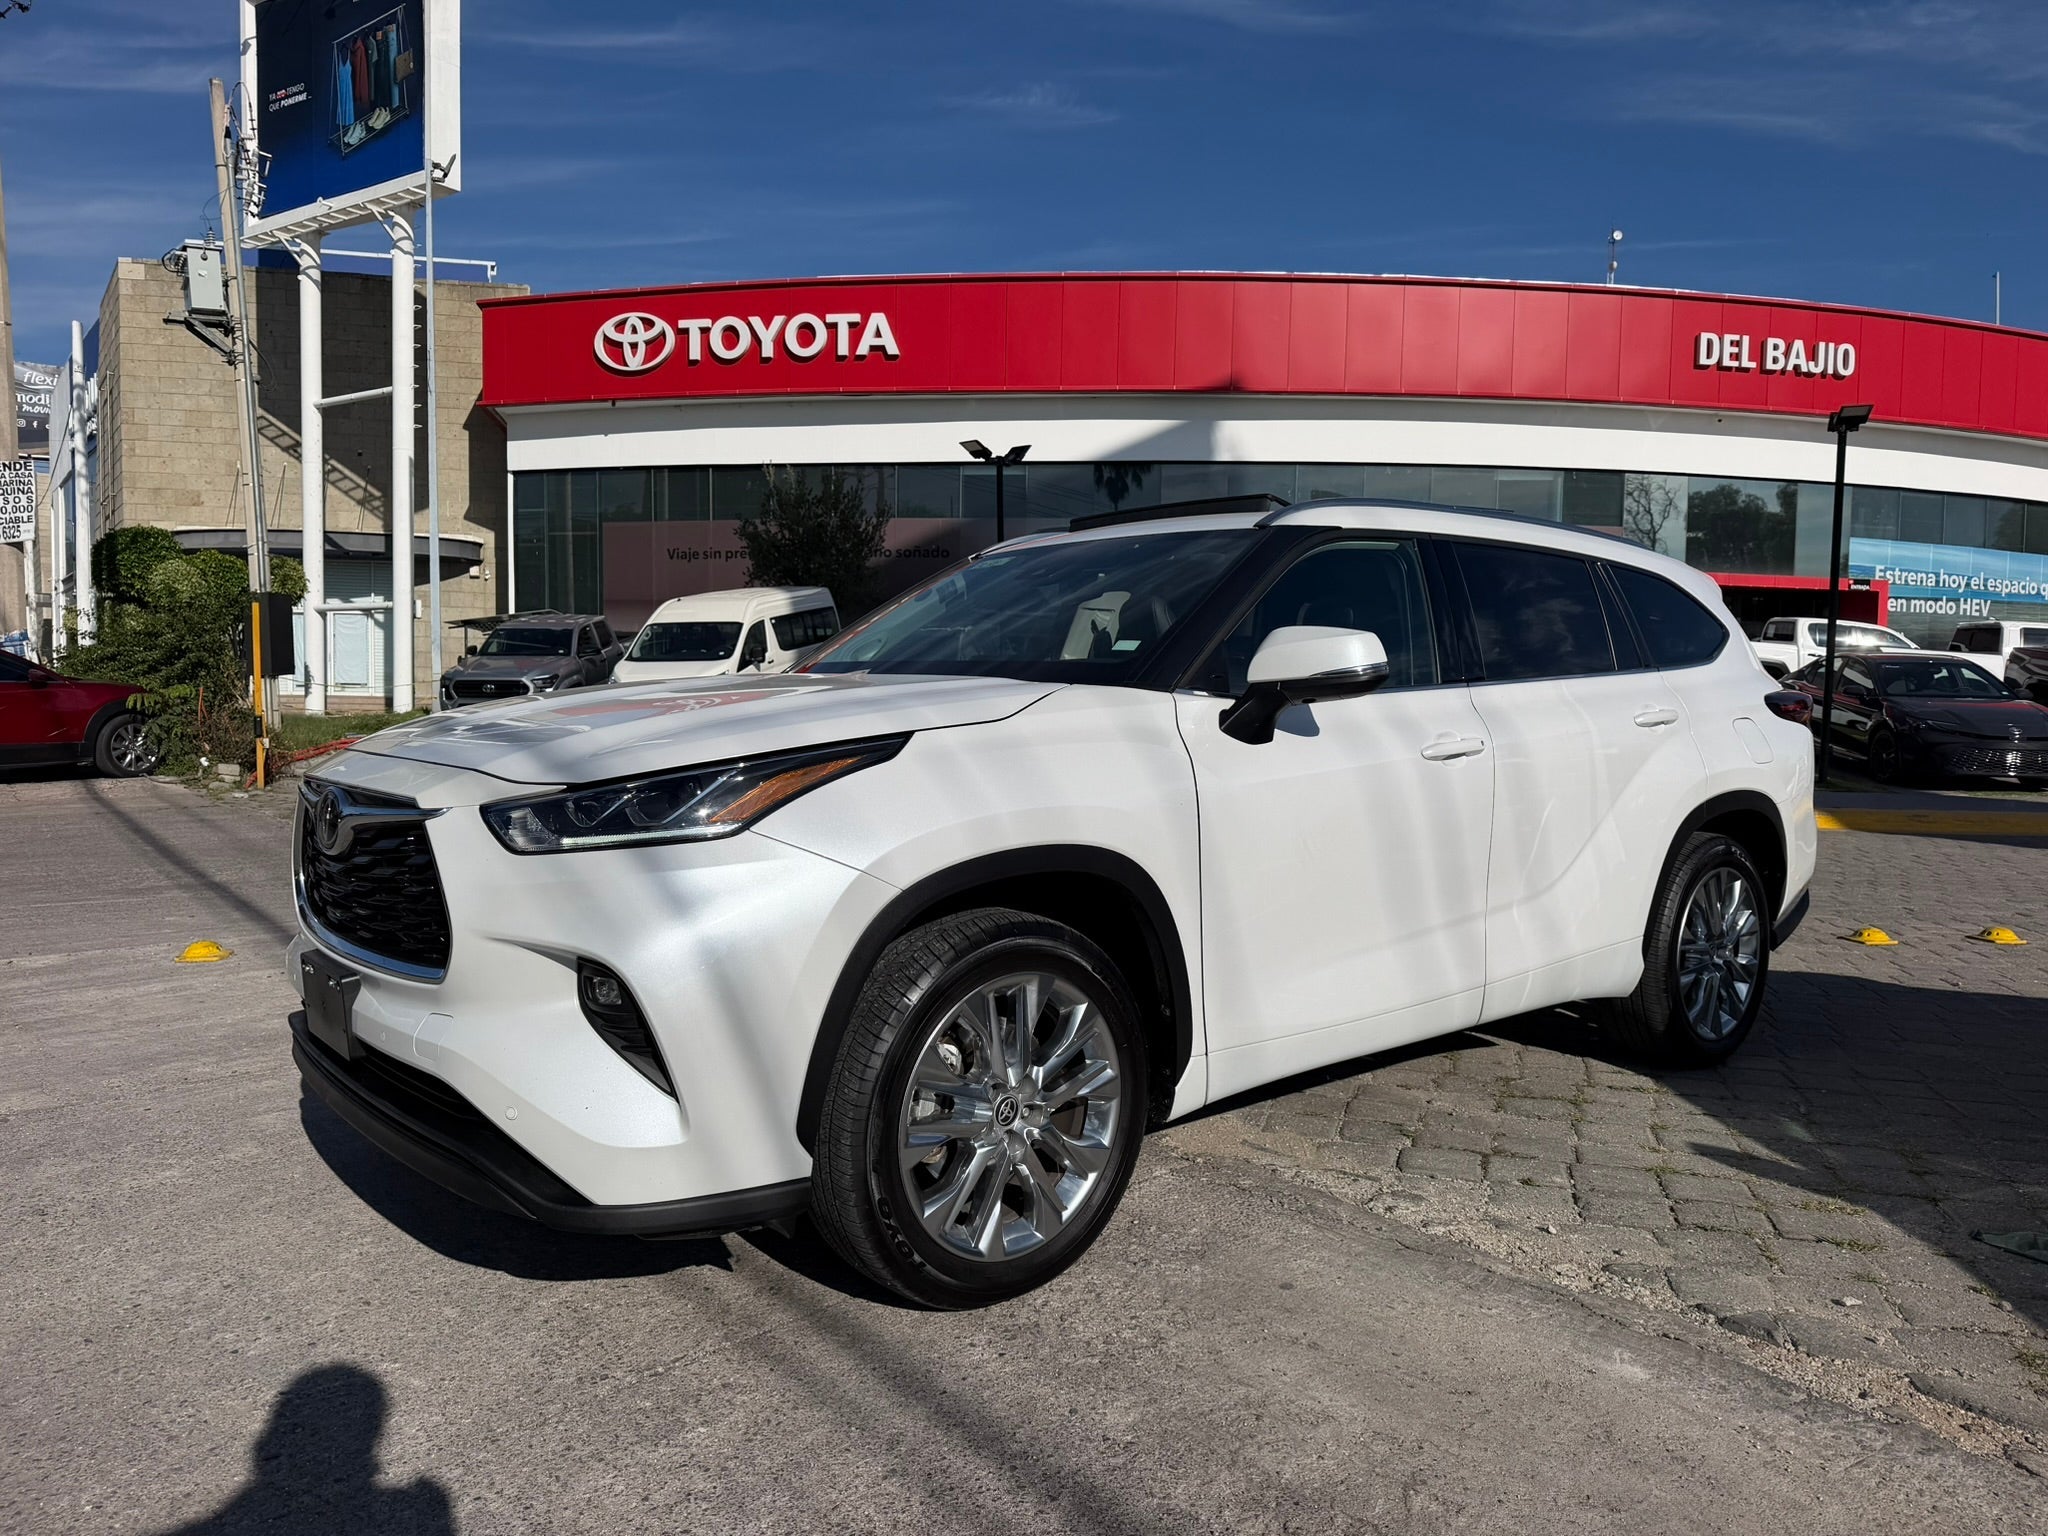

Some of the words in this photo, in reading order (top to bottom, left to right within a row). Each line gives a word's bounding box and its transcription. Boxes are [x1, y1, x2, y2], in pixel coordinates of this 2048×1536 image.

[287, 82, 305, 95] TENGO
[269, 101, 280, 112] QUE
[678, 312, 900, 361] TOYOTA
[1698, 332, 1757, 369] DEL
[1764, 337, 1856, 377] BAJIO
[24, 371, 59, 386] flexi
[0, 461, 33, 472] NDE
[0, 479, 33, 487] ARINA
[667, 547, 700, 563] Viaje
[702, 547, 722, 560] sin
[895, 544, 950, 559] soñado
[1875, 565, 1936, 587] Estrena
[1940, 568, 1968, 593] hoy
[1970, 571, 1985, 590] el
[1987, 576, 2038, 597] espacio
[1887, 597, 1907, 612] en
[1910, 596, 1957, 615] modo
[1959, 597, 1992, 617] HEV
